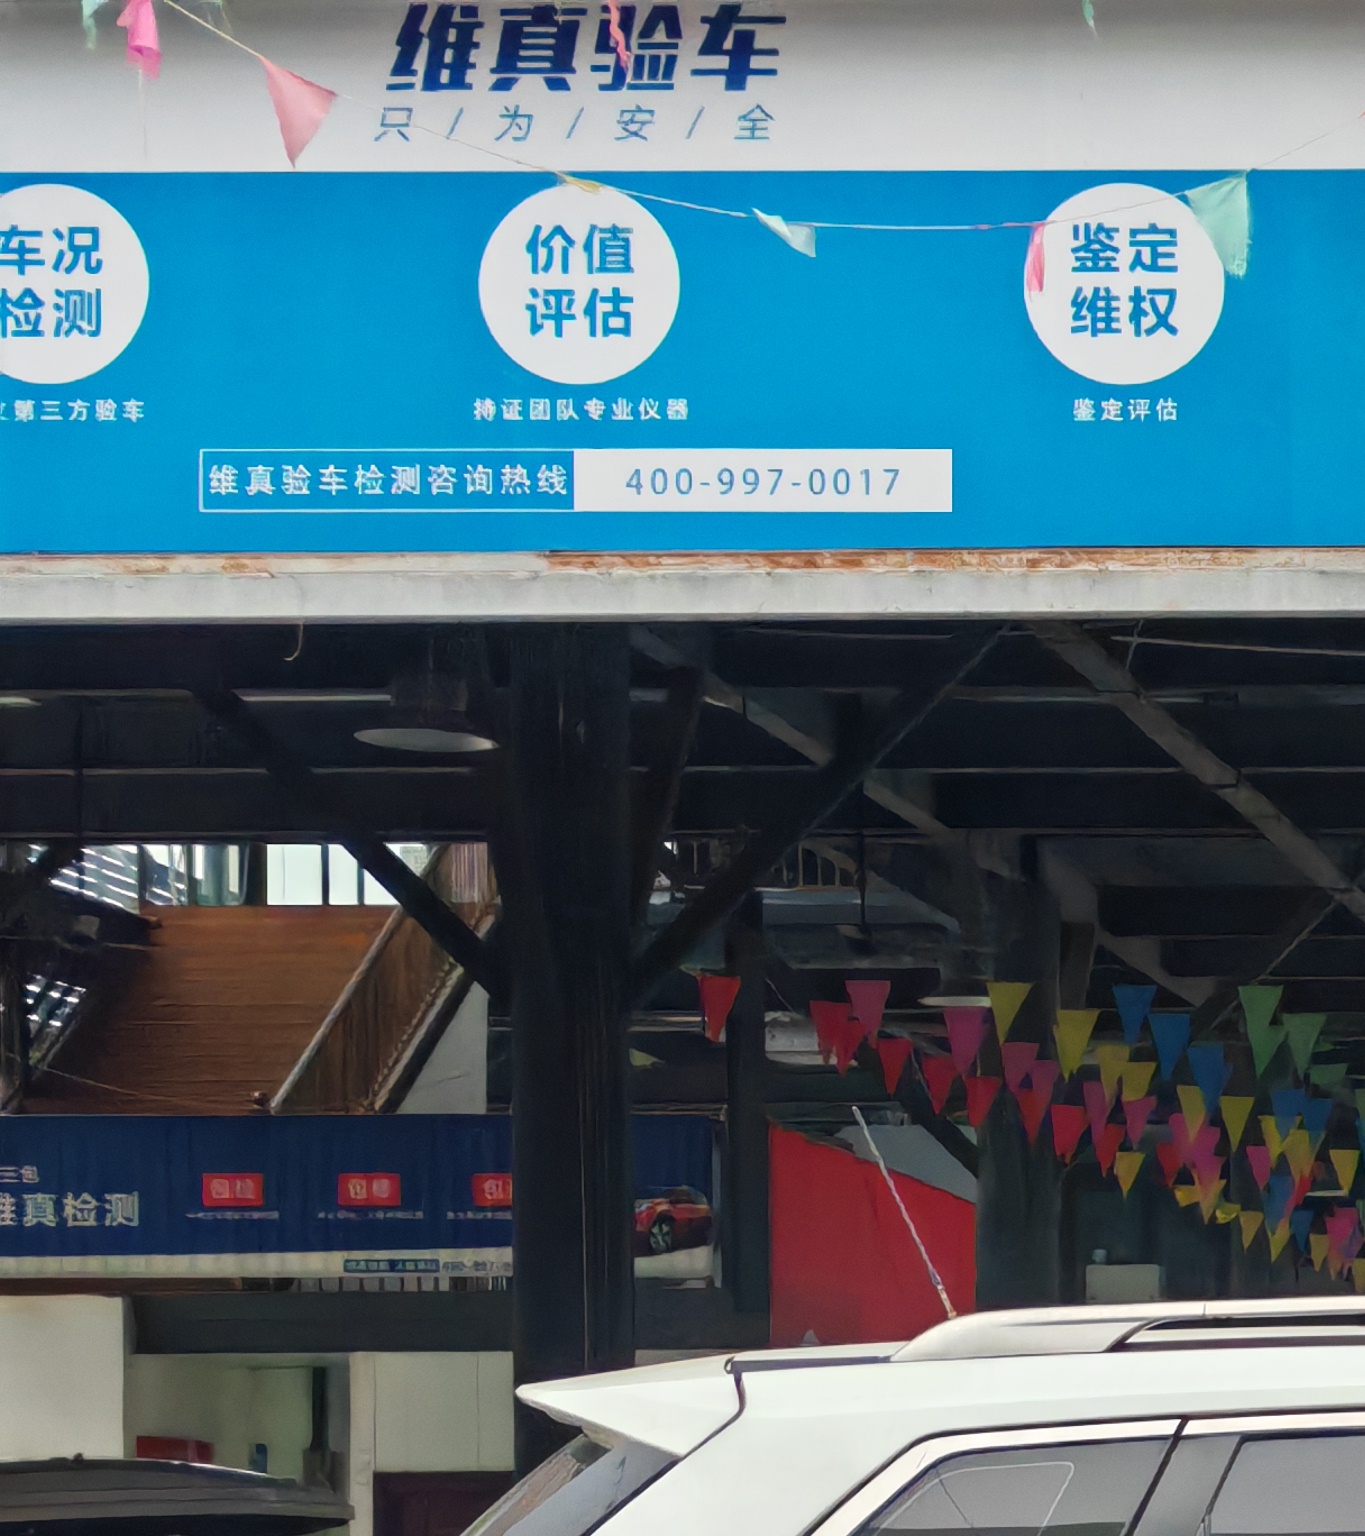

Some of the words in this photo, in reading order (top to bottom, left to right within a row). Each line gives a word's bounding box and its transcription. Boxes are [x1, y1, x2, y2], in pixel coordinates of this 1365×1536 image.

[386, 3, 786, 91] 维真验车
[0, 224, 103, 276] 车况
[525, 224, 634, 275] 价值
[1070, 223, 1179, 274] 鉴定
[0, 287, 102, 338] 检测
[525, 288, 634, 338] 评估
[1070, 286, 1179, 338] 维权
[473, 397, 689, 422] 持证团队专业仪器
[1073, 397, 1179, 422] 鉴定评估
[208, 463, 569, 497] 维真验车检测咨询热线
[625, 468, 901, 497] 400-997-0017
